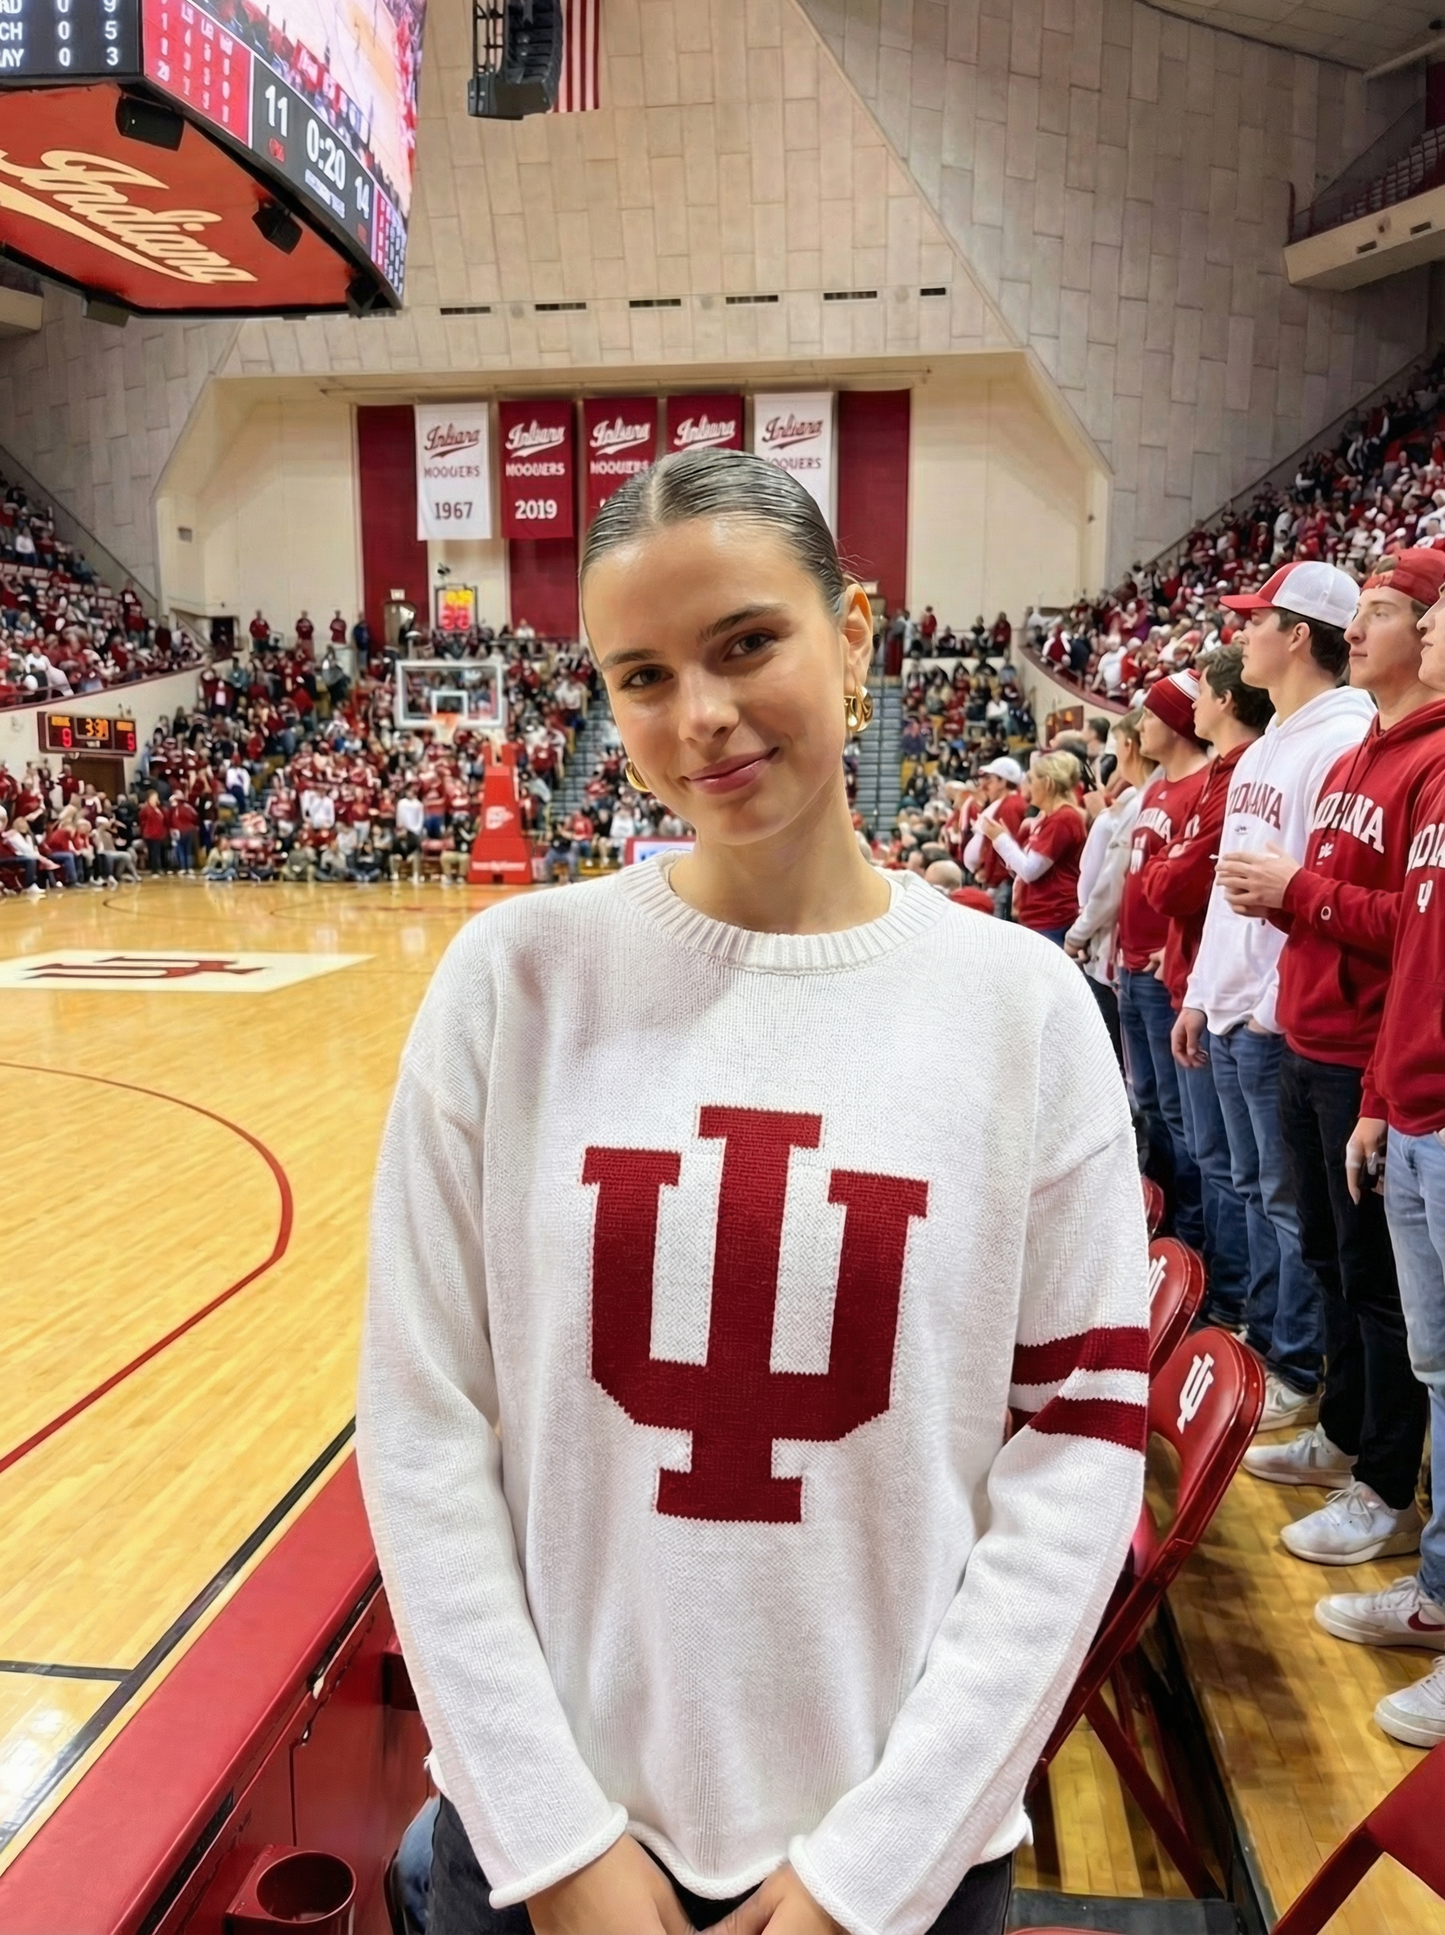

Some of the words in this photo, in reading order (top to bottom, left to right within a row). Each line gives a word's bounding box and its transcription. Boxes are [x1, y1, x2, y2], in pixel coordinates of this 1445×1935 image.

[57, 20, 70, 40] 0
[104, 20, 118, 40] 5
[58, 47, 71, 67] 0
[106, 46, 119, 66] 3
[265, 84, 288, 138] 11
[306, 118, 346, 190] 0:20
[354, 176, 370, 220] 14
[0, 149, 259, 285] Indiana
[434, 501, 473, 520] 1967
[514, 499, 558, 520] 2019
